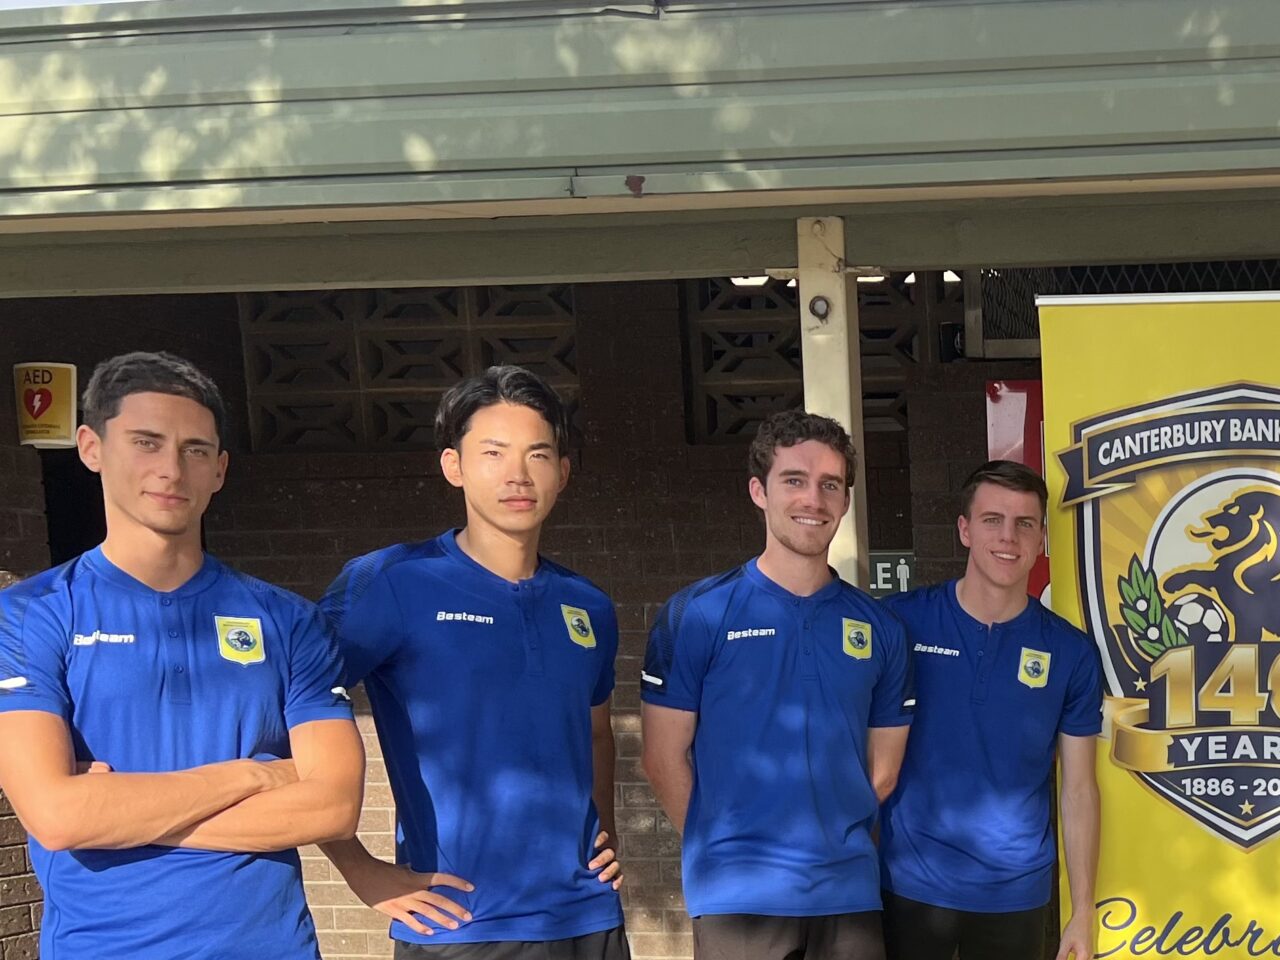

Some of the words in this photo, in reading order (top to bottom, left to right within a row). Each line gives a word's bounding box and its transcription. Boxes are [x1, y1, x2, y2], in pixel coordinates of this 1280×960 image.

[23, 369, 53, 385] AED
[1097, 418, 1226, 466] CANTERBURY
[436, 610, 494, 625] Besteam
[727, 628, 776, 641] Besteam
[913, 643, 961, 657] Besteam
[1181, 777, 1235, 797] 1886
